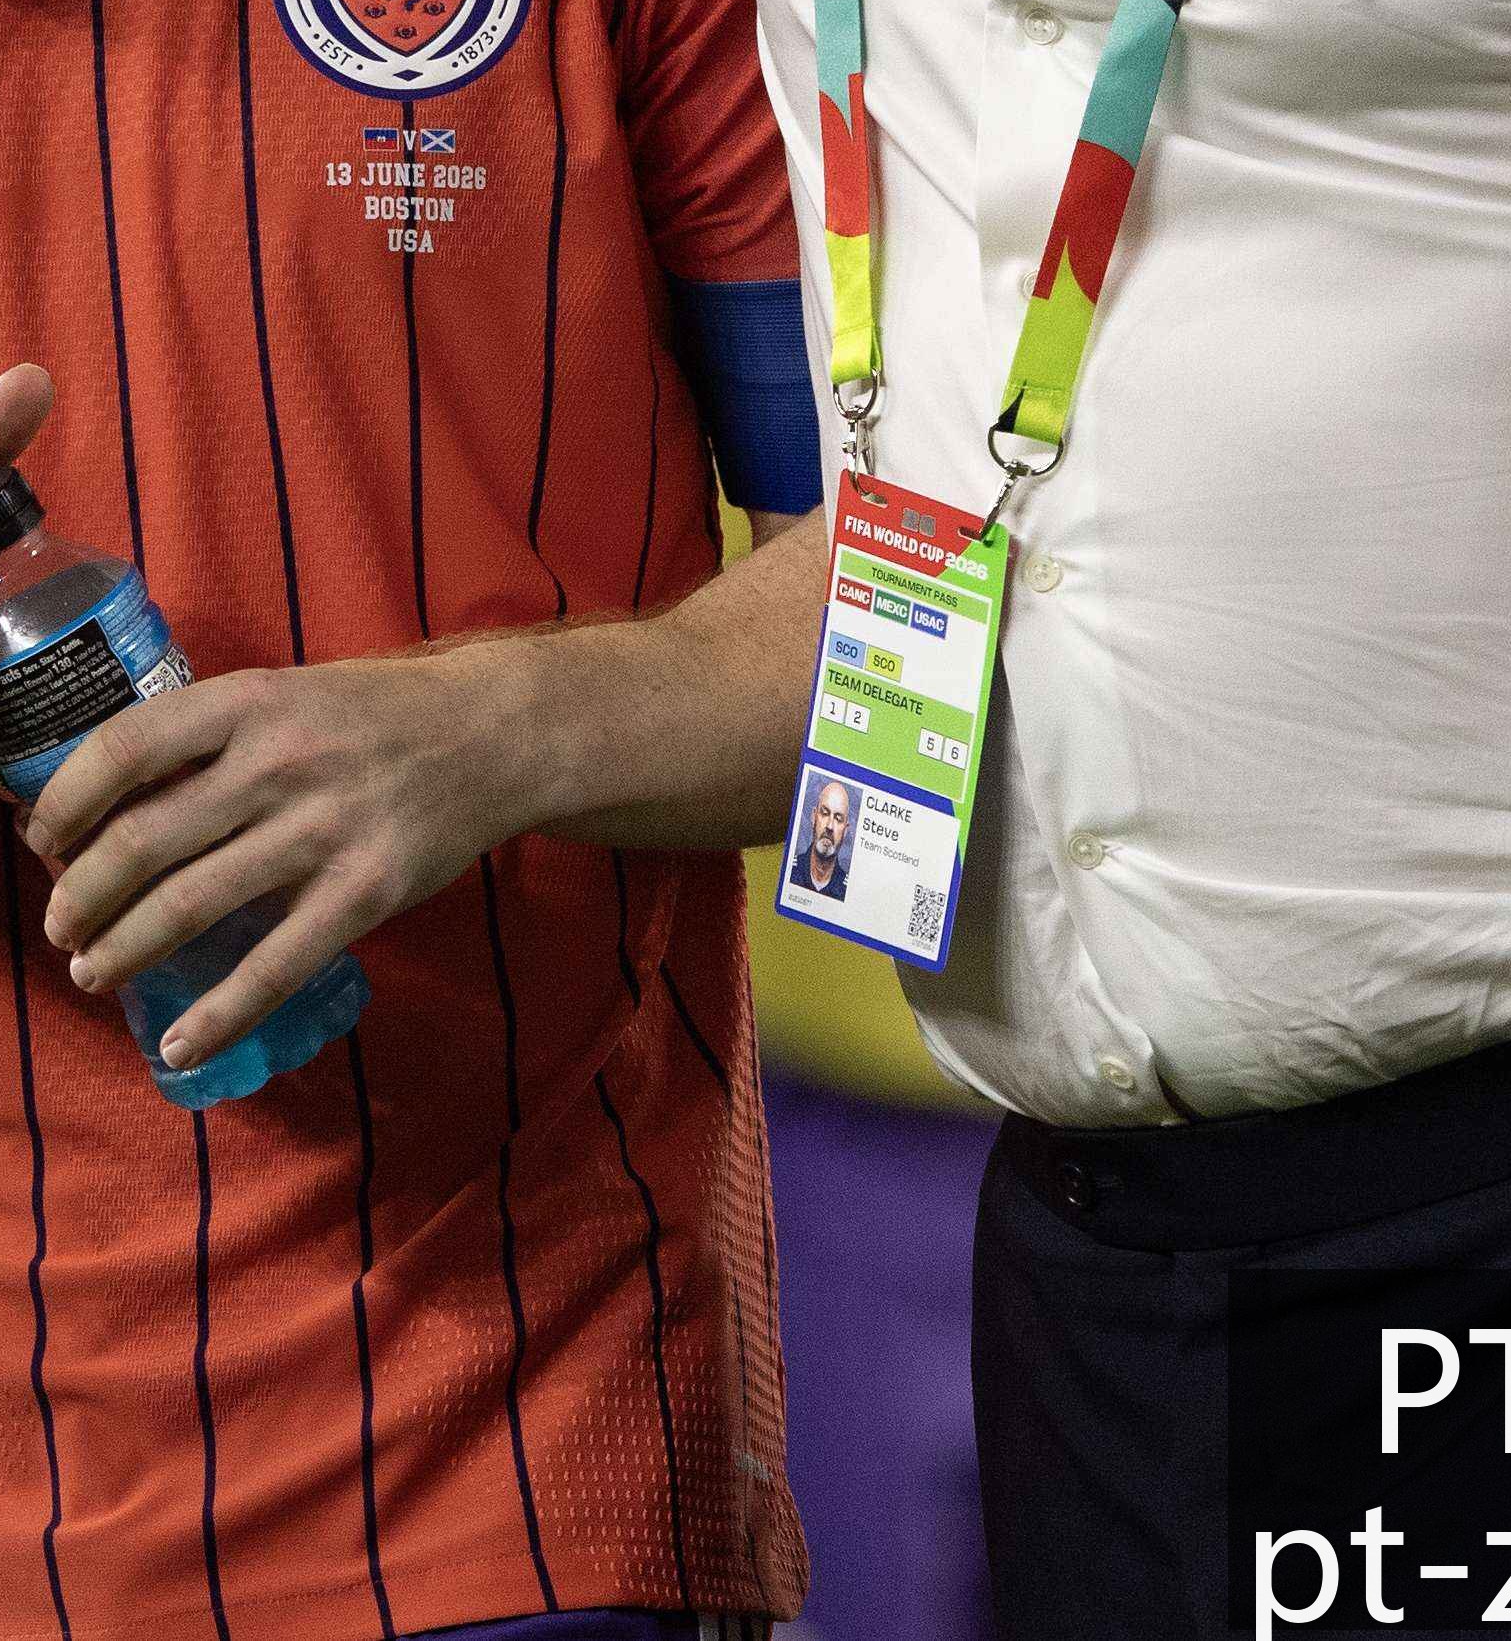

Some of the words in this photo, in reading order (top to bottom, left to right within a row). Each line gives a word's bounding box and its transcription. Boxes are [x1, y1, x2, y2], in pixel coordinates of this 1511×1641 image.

[319, 39, 353, 67] EST
[458, 31, 495, 65] 1873
[403, 130, 417, 150] V
[325, 162, 352, 186] 13
[360, 162, 426, 188] JUNE
[433, 164, 487, 190] 2026
[364, 196, 455, 222] BOSTON
[388, 229, 434, 253] USA
[845, 515, 873, 538] FIFA
[873, 524, 919, 554] WORLD
[919, 541, 944, 563] CUP
[944, 551, 987, 580] 2026
[872, 567, 933, 600] TOURNAMENT
[933, 586, 958, 608] PASS
[876, 597, 908, 619] MEXC
[914, 610, 945, 632] USAC
[835, 641, 858, 659] SCO
[873, 654, 895, 672] SCO
[827, 669, 863, 694] TEAM
[863, 682, 923, 715] DELEGATE
[830, 702, 836, 715] 1
[853, 711, 862, 724] 2
[926, 738, 935, 751] 5
[950, 746, 959, 760] 6
[866, 796, 913, 824] CLARKE
[862, 817, 899, 842] Steve
[859, 837, 883, 855] Team
[882, 846, 919, 868] Scotland
